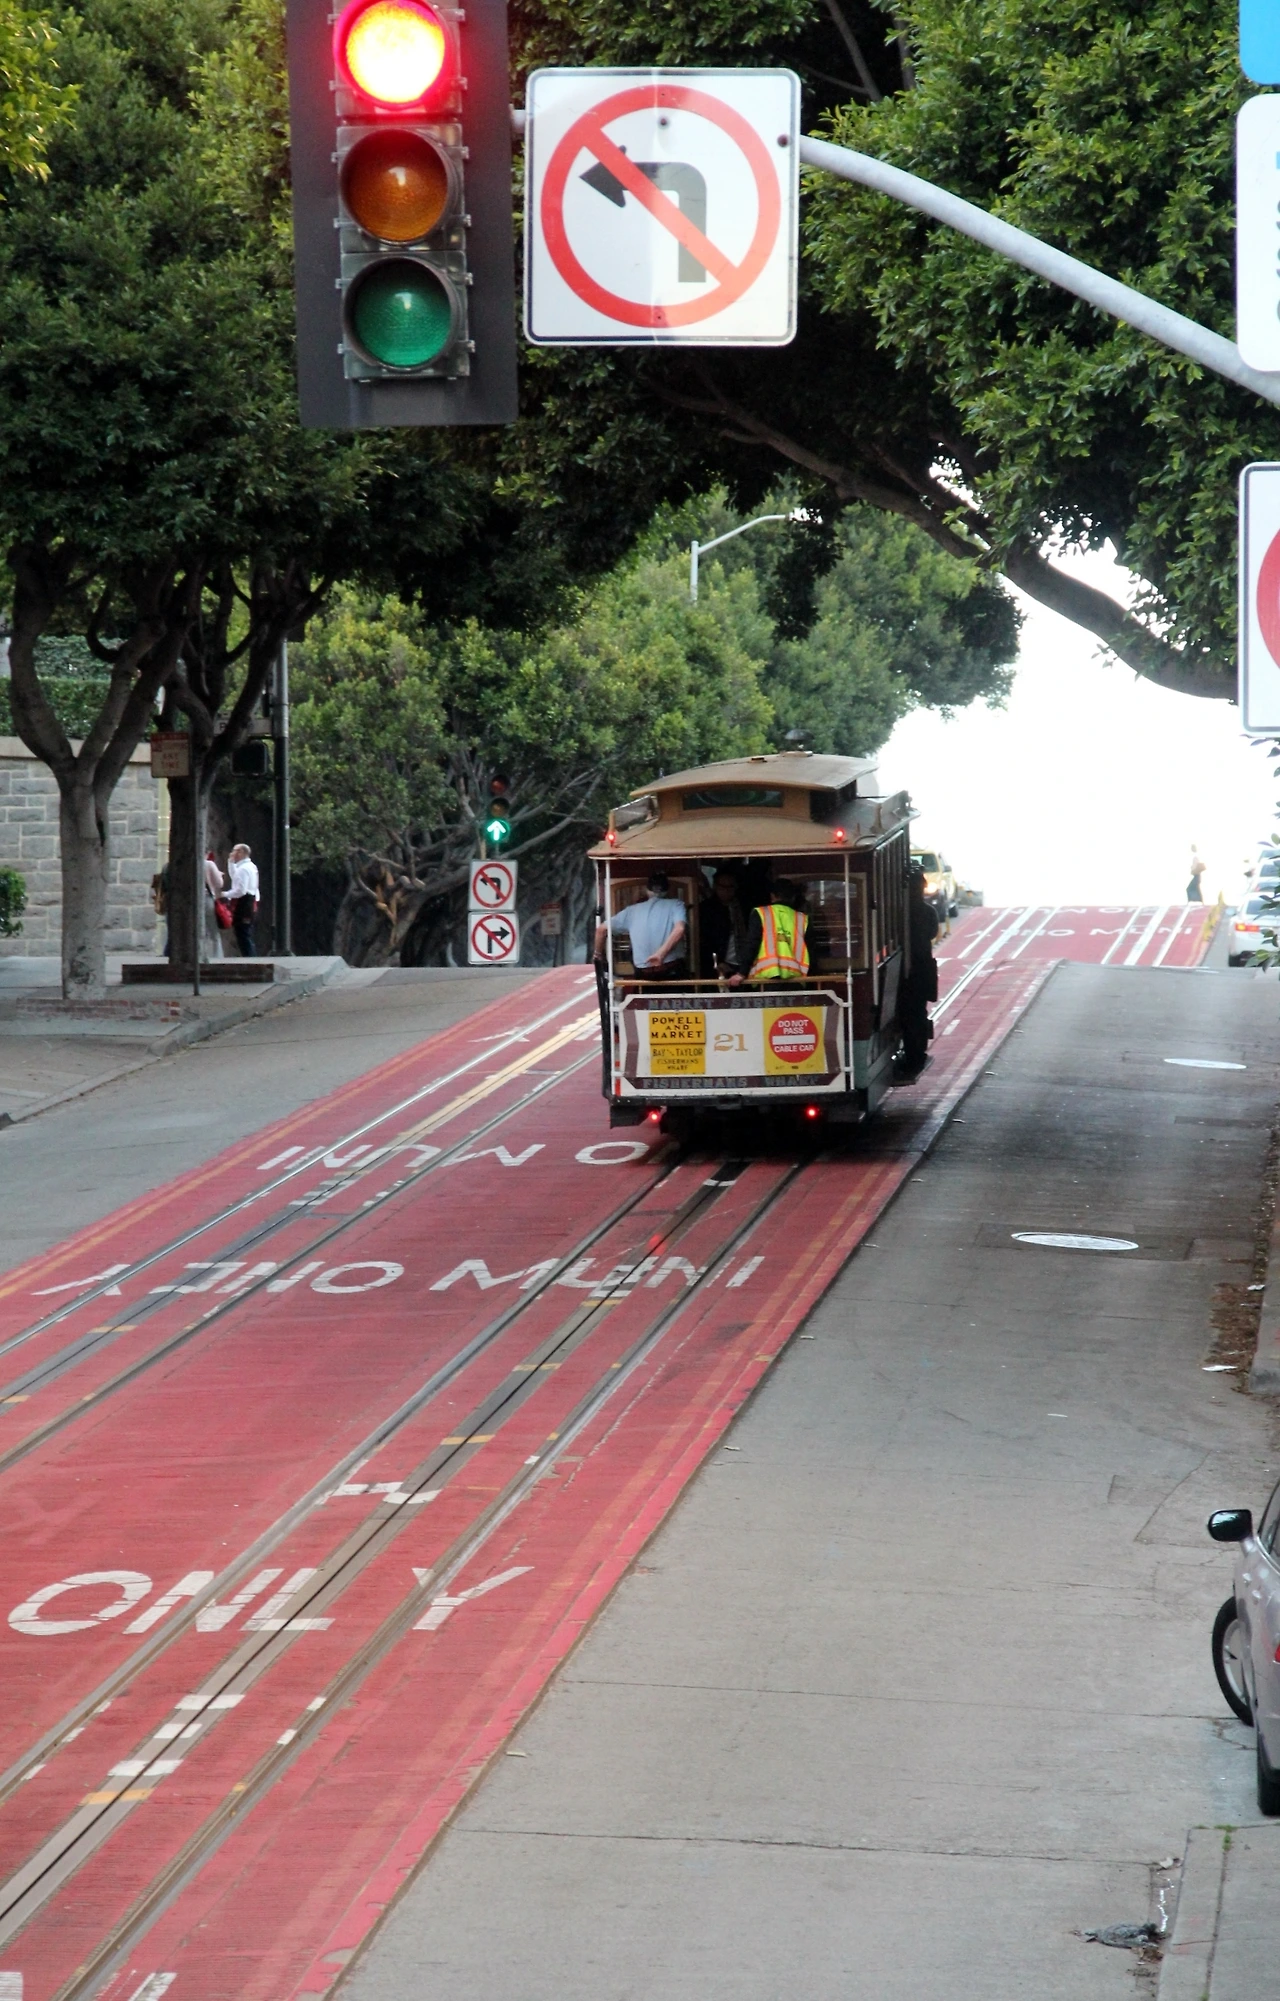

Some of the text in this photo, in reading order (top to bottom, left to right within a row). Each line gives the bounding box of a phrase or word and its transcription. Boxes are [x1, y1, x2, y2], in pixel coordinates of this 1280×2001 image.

[648, 998, 714, 1010] MARKET
[731, 996, 795, 1009] STREET
[652, 1016, 702, 1025] POWELL
[778, 1019, 809, 1028] DO NOT
[651, 1030, 702, 1039] MARKET
[783, 1027, 804, 1035] PASS
[714, 1033, 748, 1052] 21
[652, 1048, 666, 1057] BAY
[676, 1047, 704, 1057] TAYLOR
[774, 1044, 815, 1053] CABLE CAR
[643, 1077, 748, 1089] FISHERMANS
[9, 1566, 535, 1636] ONLY
